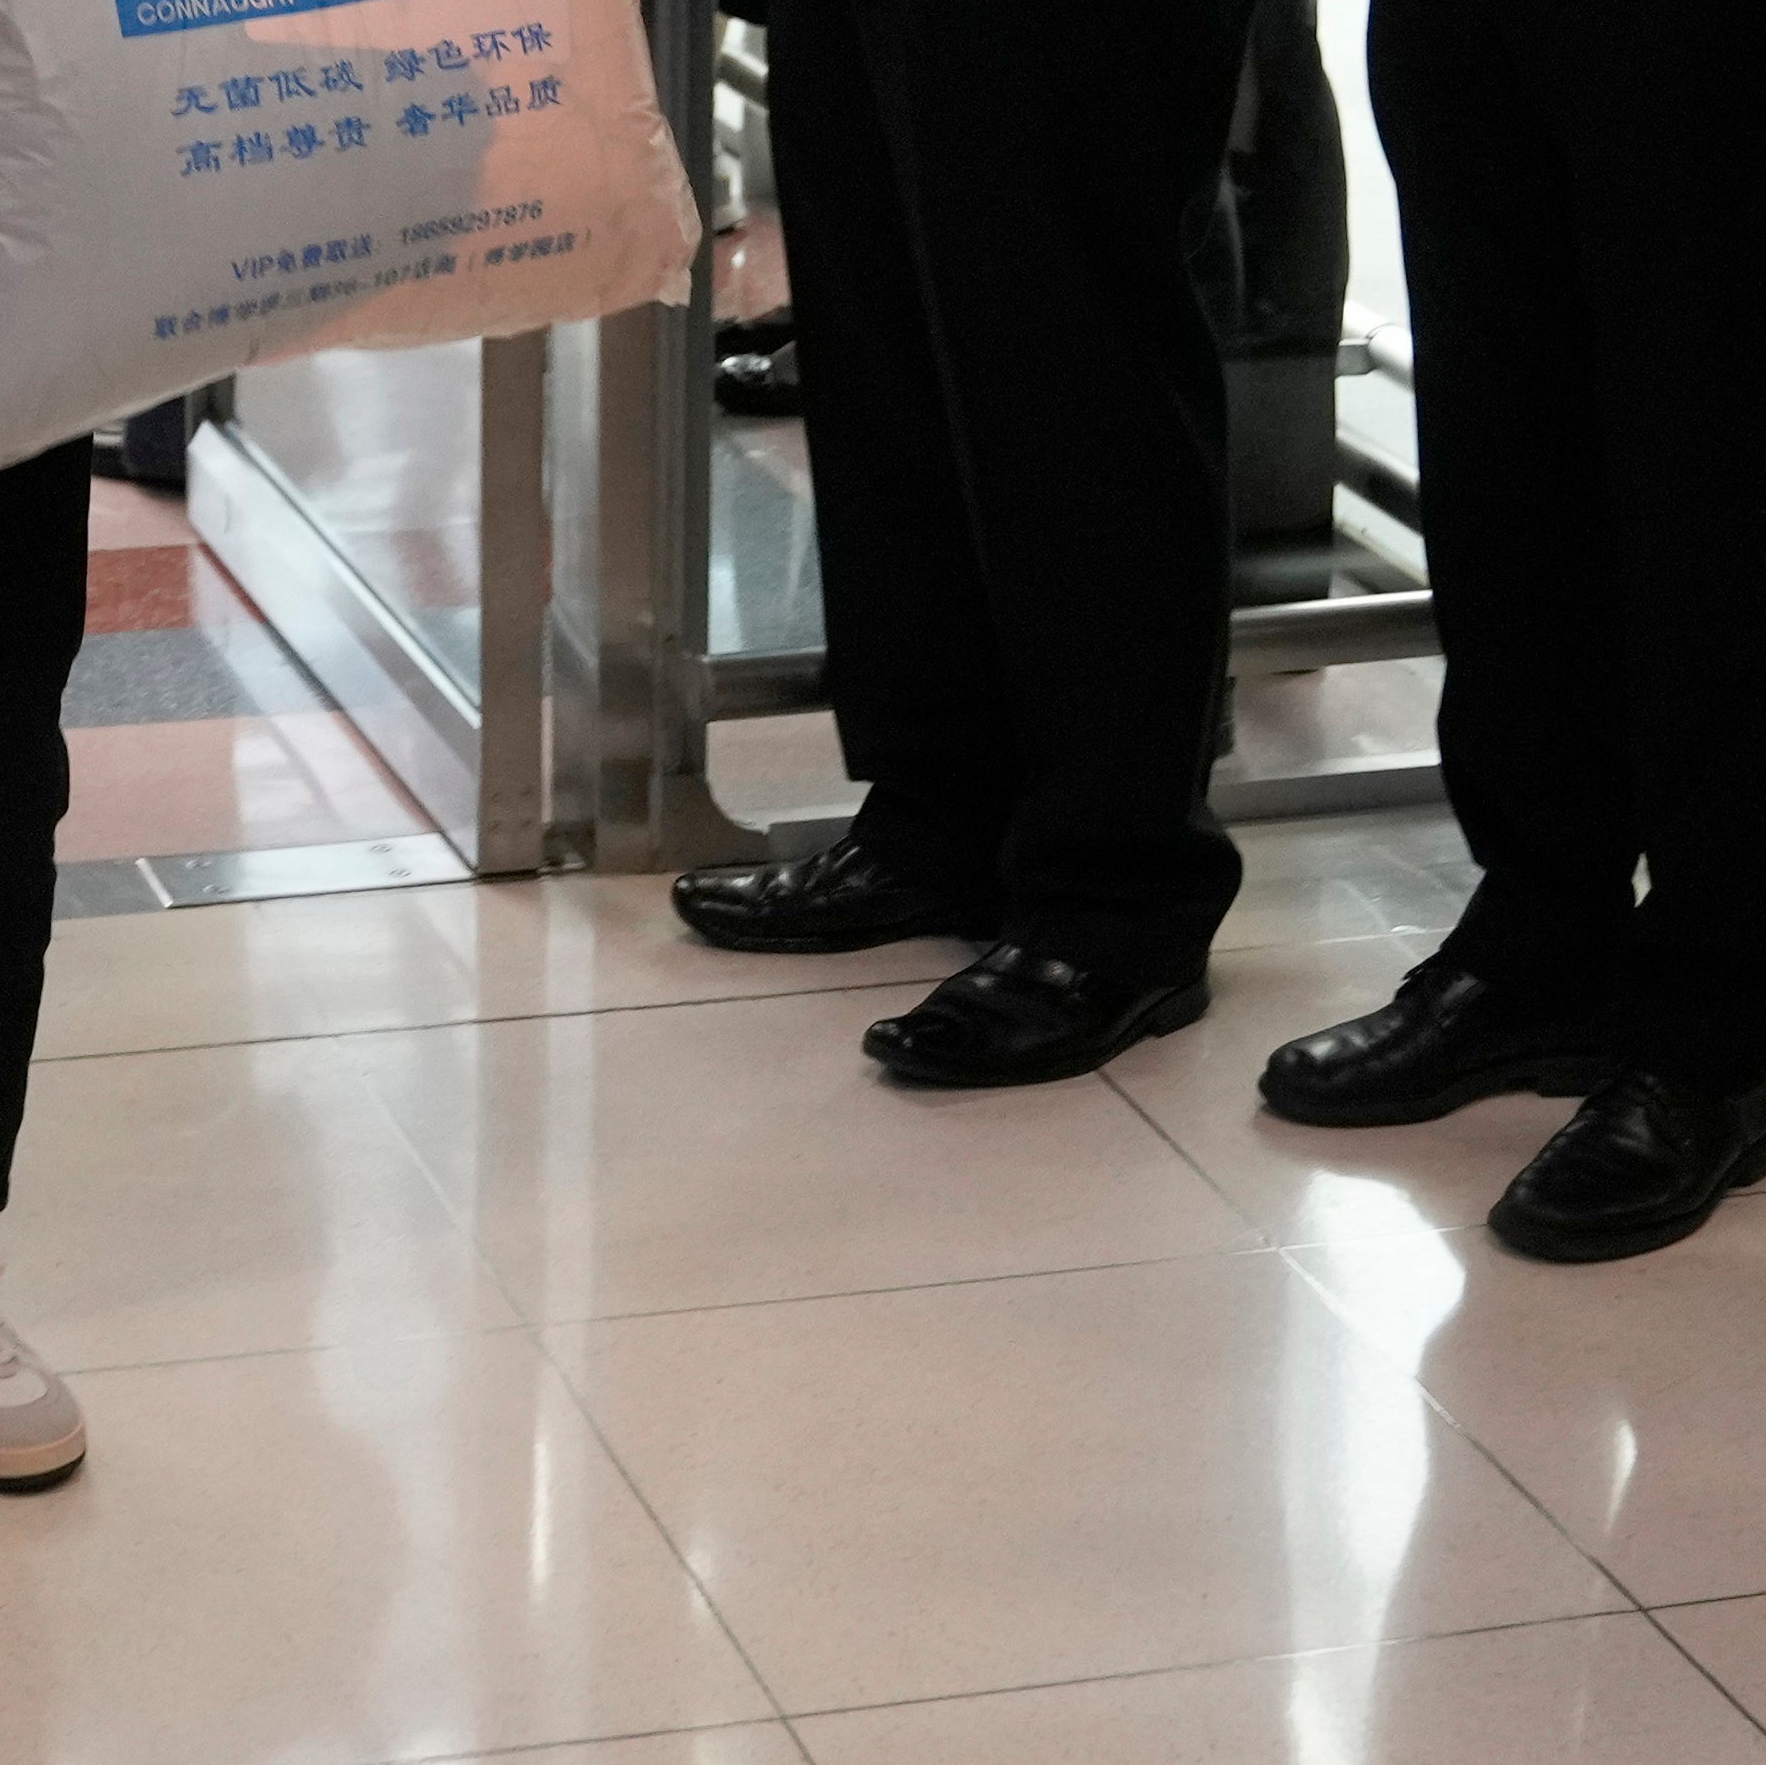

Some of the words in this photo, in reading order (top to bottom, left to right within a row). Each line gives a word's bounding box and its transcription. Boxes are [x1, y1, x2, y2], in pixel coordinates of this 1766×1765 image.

[382, 21, 553, 84] 绿色环保
[174, 115, 371, 178] 高档尊贵
[395, 75, 564, 138] 奢华品质
